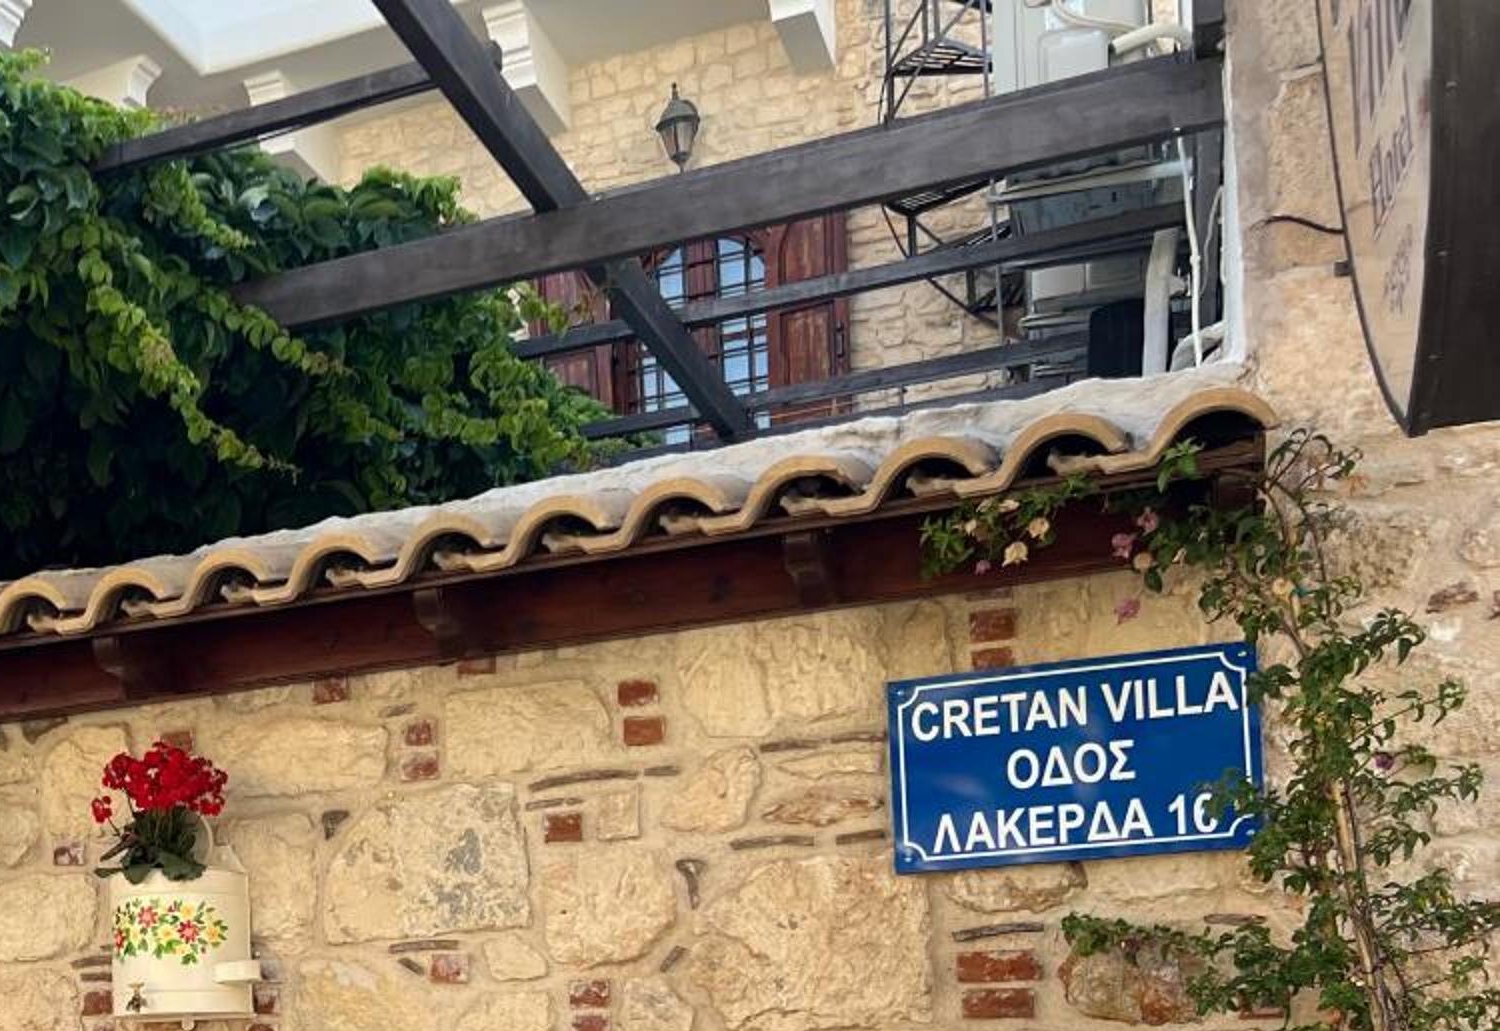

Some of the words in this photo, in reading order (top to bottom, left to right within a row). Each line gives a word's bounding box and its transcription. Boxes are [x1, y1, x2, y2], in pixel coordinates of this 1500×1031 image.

[911, 685, 1088, 742] CRETAN
[1101, 671, 1240, 724] VILLA
[1007, 739, 1137, 790] ΟΔΟΣ
[933, 797, 1154, 855] ΛΑΚΕΡΔΑ
